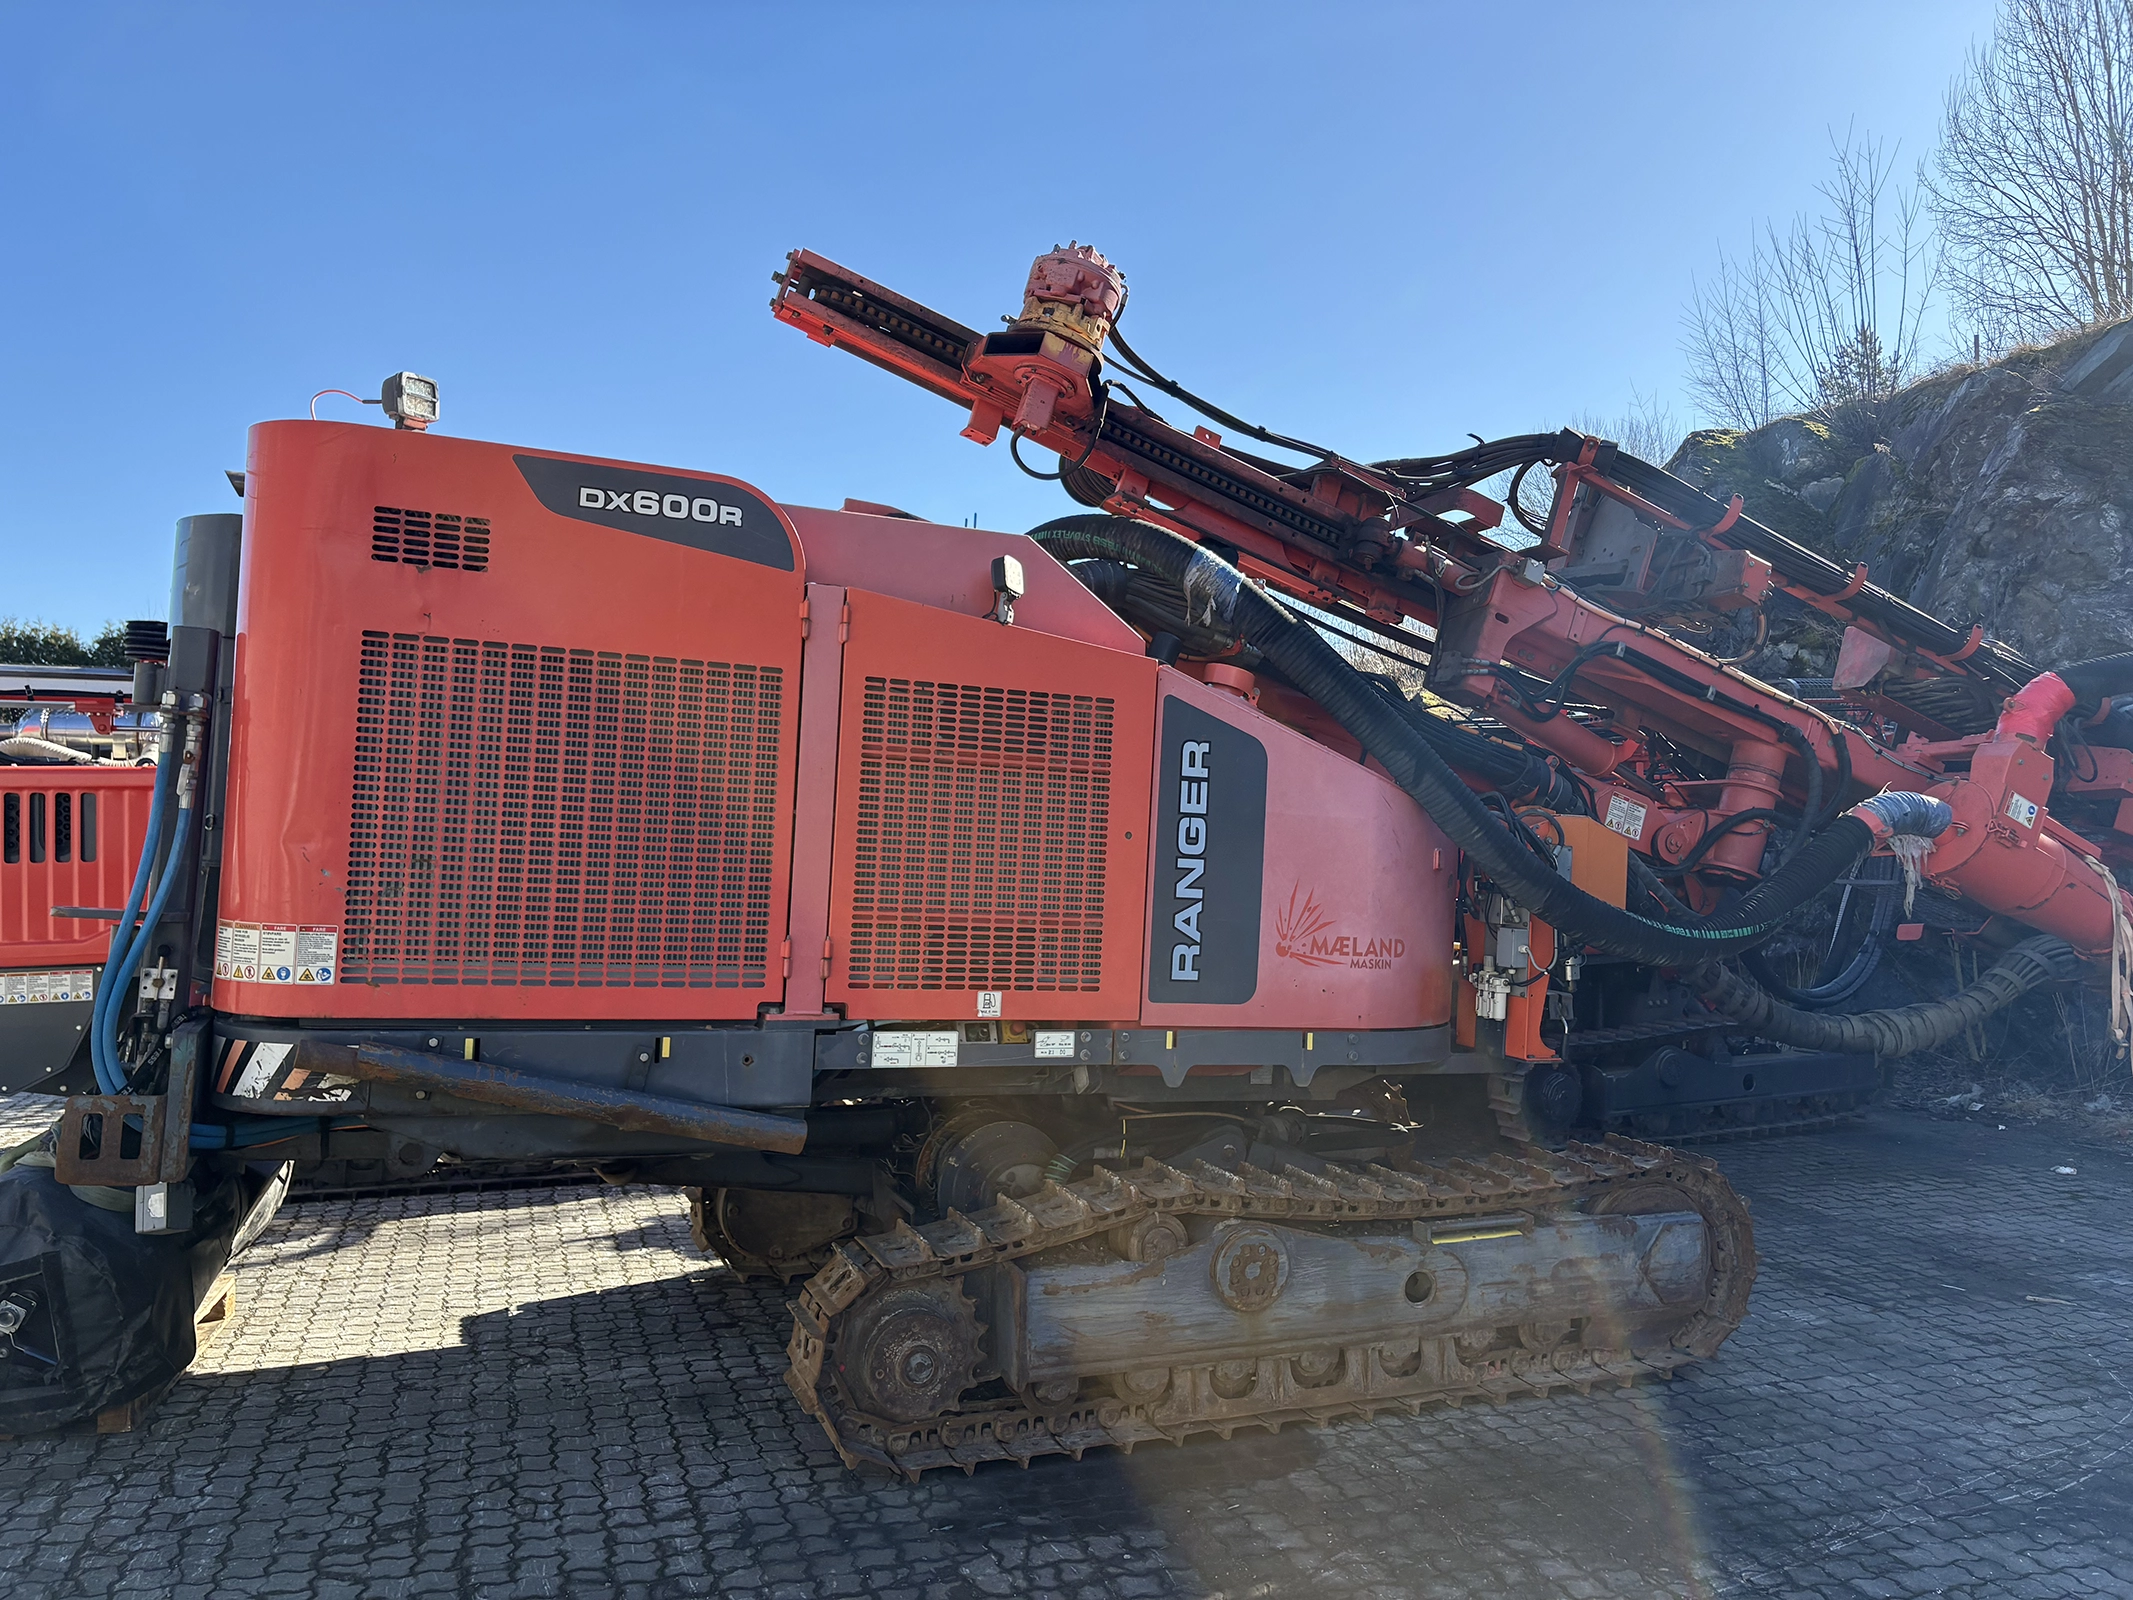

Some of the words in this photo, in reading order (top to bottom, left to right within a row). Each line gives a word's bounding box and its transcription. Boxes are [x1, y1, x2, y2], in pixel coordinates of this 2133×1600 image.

[579, 486, 743, 527] DX600R
[1170, 740, 1210, 981] RANGER
[1309, 936, 1406, 959] MÆLAND
[1350, 958, 1392, 970] MASKIN
[147, 1048, 163, 1066] TESS
